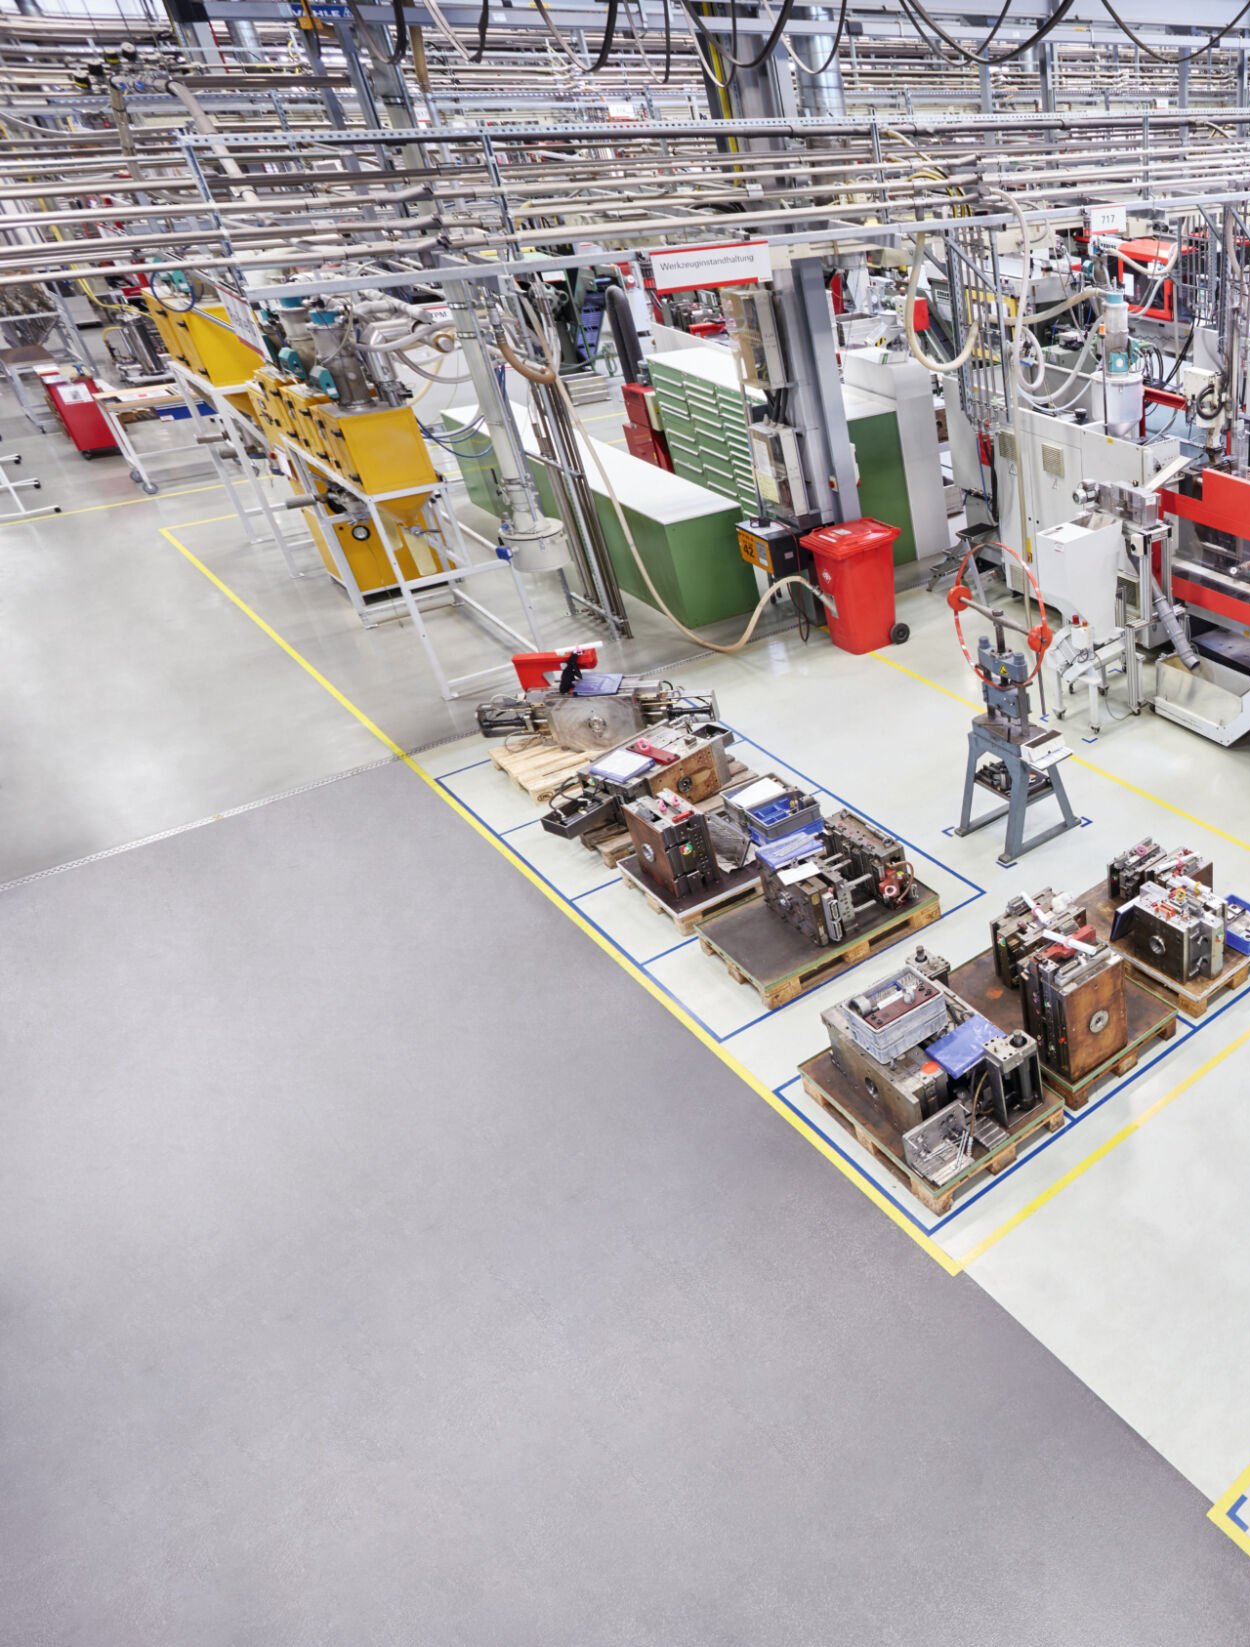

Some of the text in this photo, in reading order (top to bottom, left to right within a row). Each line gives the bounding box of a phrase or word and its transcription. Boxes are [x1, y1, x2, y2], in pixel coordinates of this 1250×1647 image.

[1101, 214, 1115, 224] 717
[660, 254, 754, 271] Werkzeuginstandhaltung
[743, 543, 755, 558] 42
